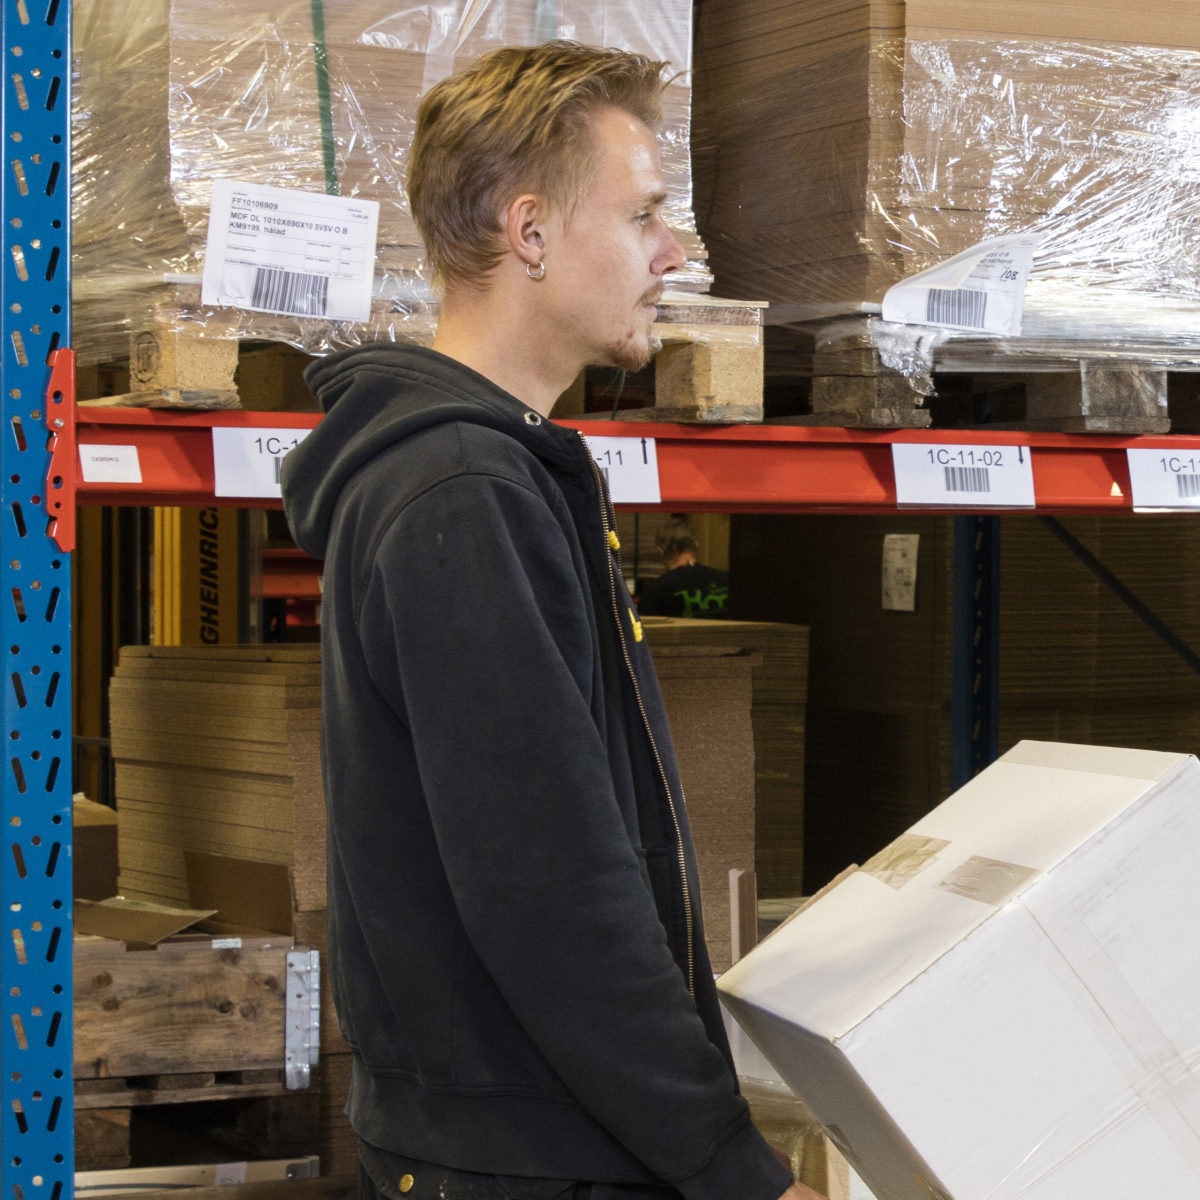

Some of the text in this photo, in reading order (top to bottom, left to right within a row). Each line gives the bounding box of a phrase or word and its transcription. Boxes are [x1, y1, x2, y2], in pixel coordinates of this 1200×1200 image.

[231, 197, 279, 210] FF10106909
[230, 211, 248, 221] MDF
[250, 214, 261, 223] DL
[263, 216, 313, 230] 1010X690X10
[315, 223, 333, 233] SVSV
[342, 227, 348, 235] B
[1000, 269, 1019, 280] 108
[926, 448, 1004, 467] 1C-11-02
[200, 507, 219, 645] GHEINRIC
